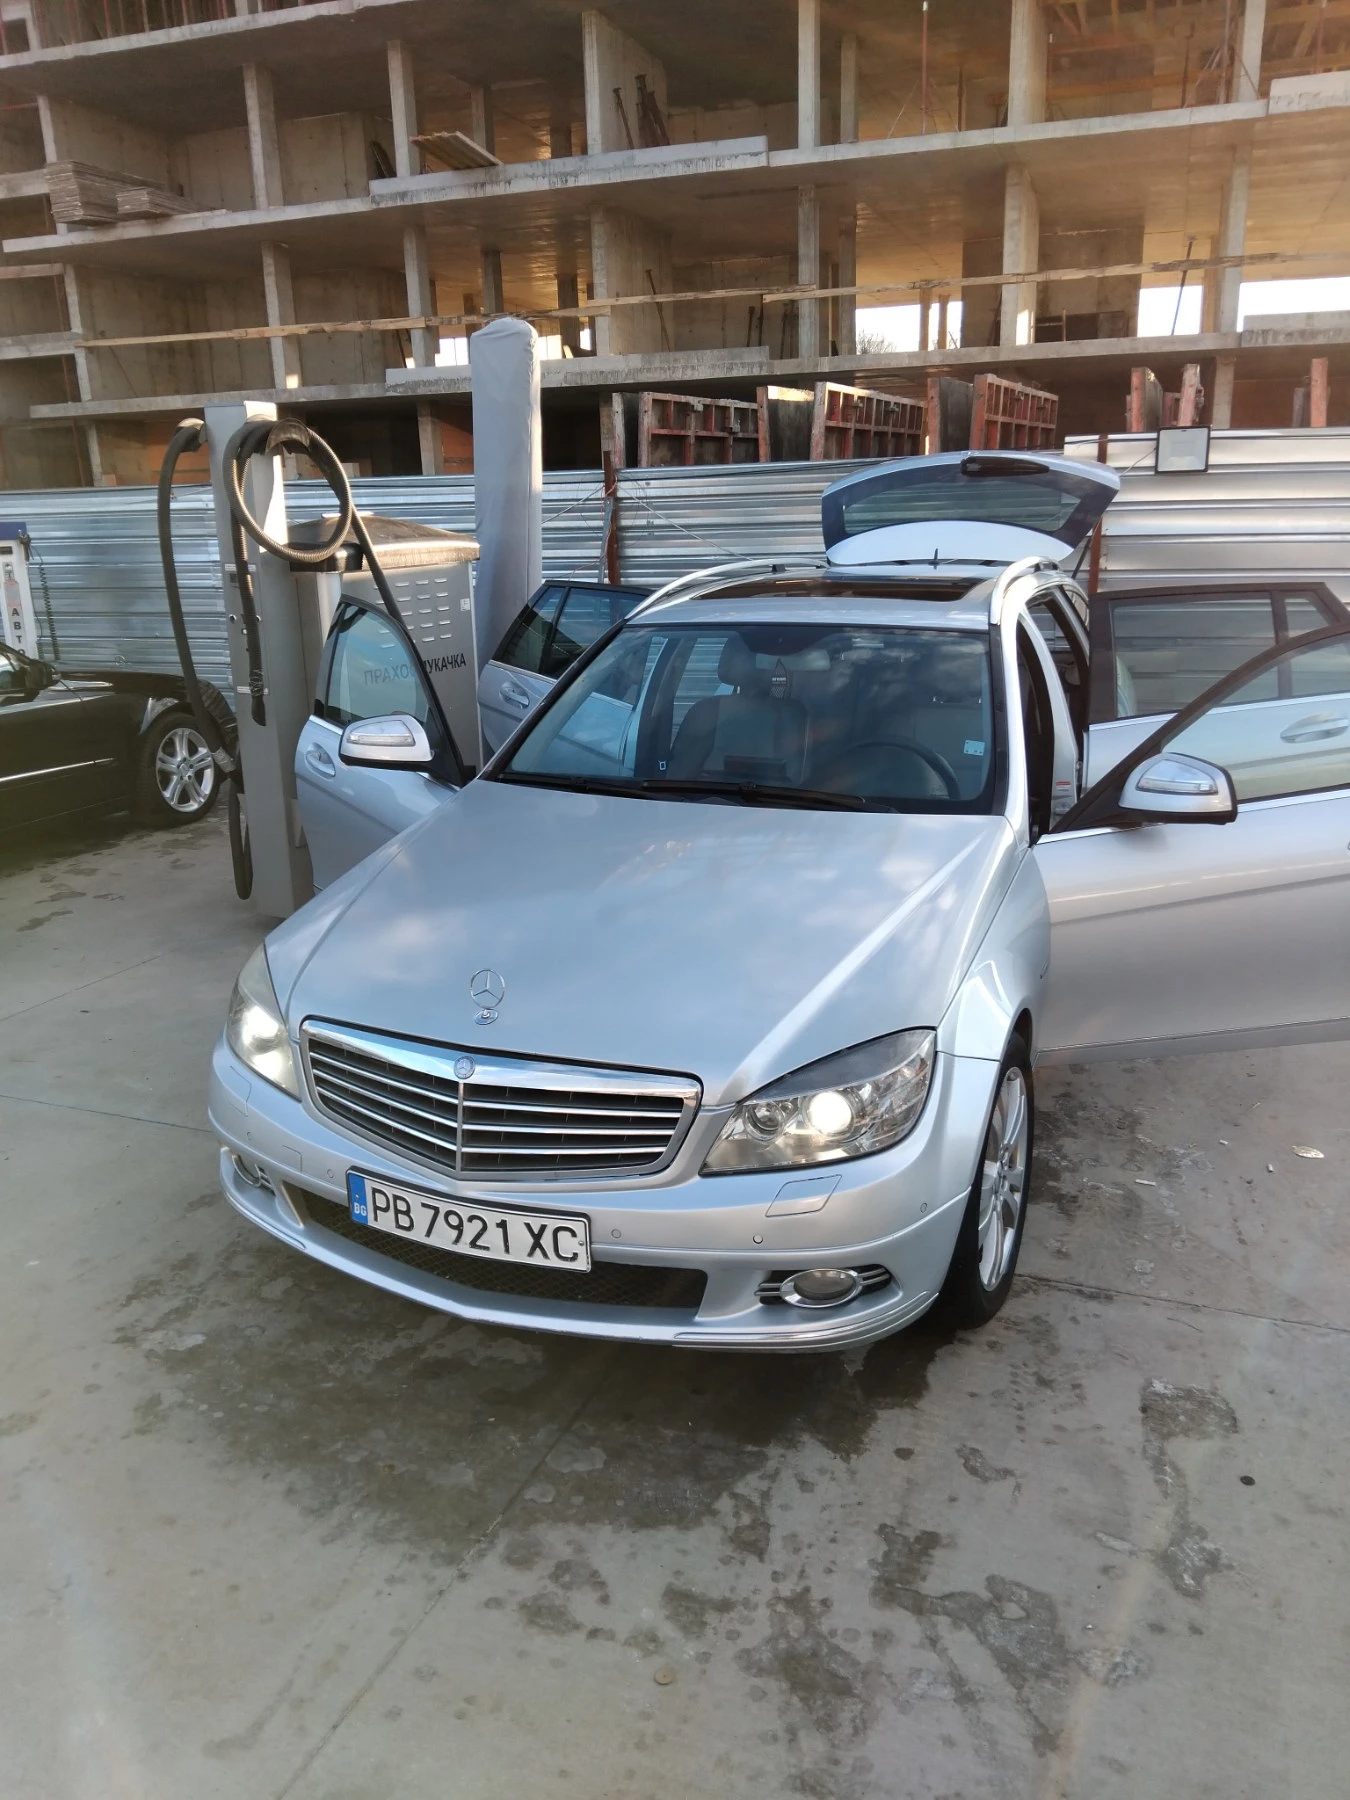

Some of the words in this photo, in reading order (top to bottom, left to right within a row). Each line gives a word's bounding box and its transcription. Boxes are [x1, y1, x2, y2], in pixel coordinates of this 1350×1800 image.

[364, 653, 467, 685] ПРАХОСУКАЧКА
[353, 1202, 367, 1217] BG
[371, 1187, 415, 1232] PB
[420, 1201, 512, 1255] 7921
[523, 1221, 580, 1263] XC
